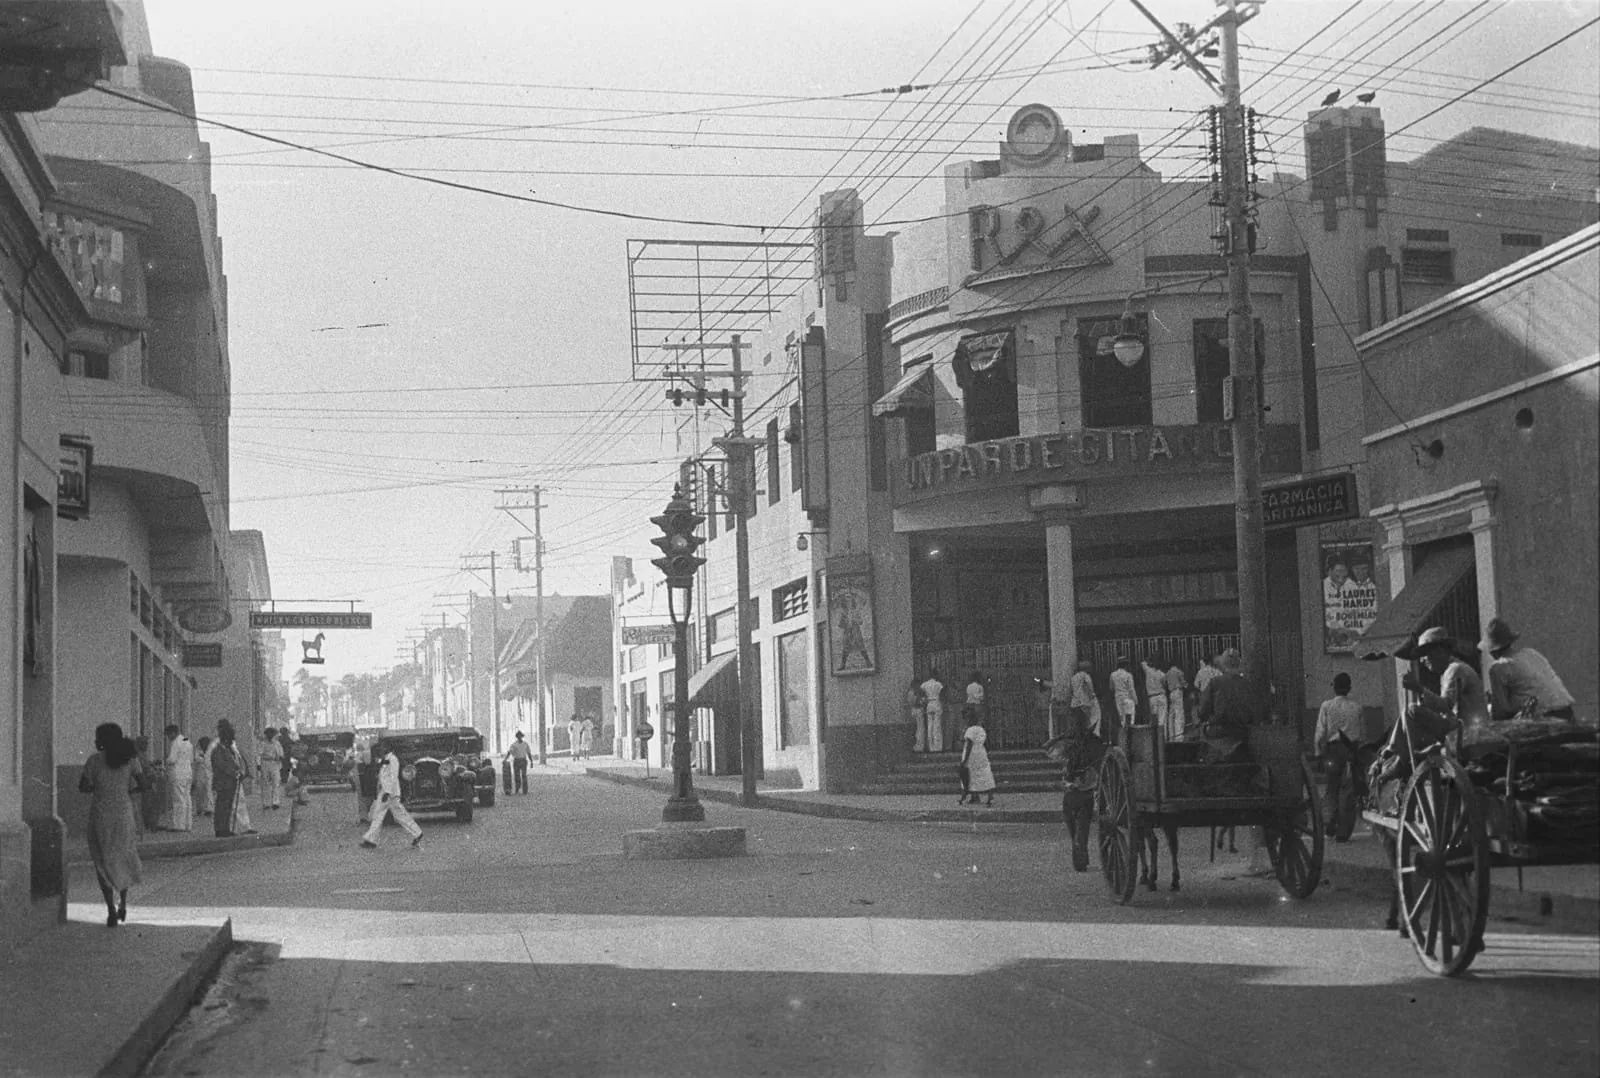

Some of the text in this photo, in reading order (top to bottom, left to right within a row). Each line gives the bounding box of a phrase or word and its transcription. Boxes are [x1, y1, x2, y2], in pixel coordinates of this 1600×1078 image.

[938, 442, 1002, 481] PAR
[1009, 437, 1065, 473] DE
[1260, 481, 1344, 507] FARMACIA
[1343, 588, 1375, 599] LAUREL
[1343, 598, 1375, 608] HARDY
